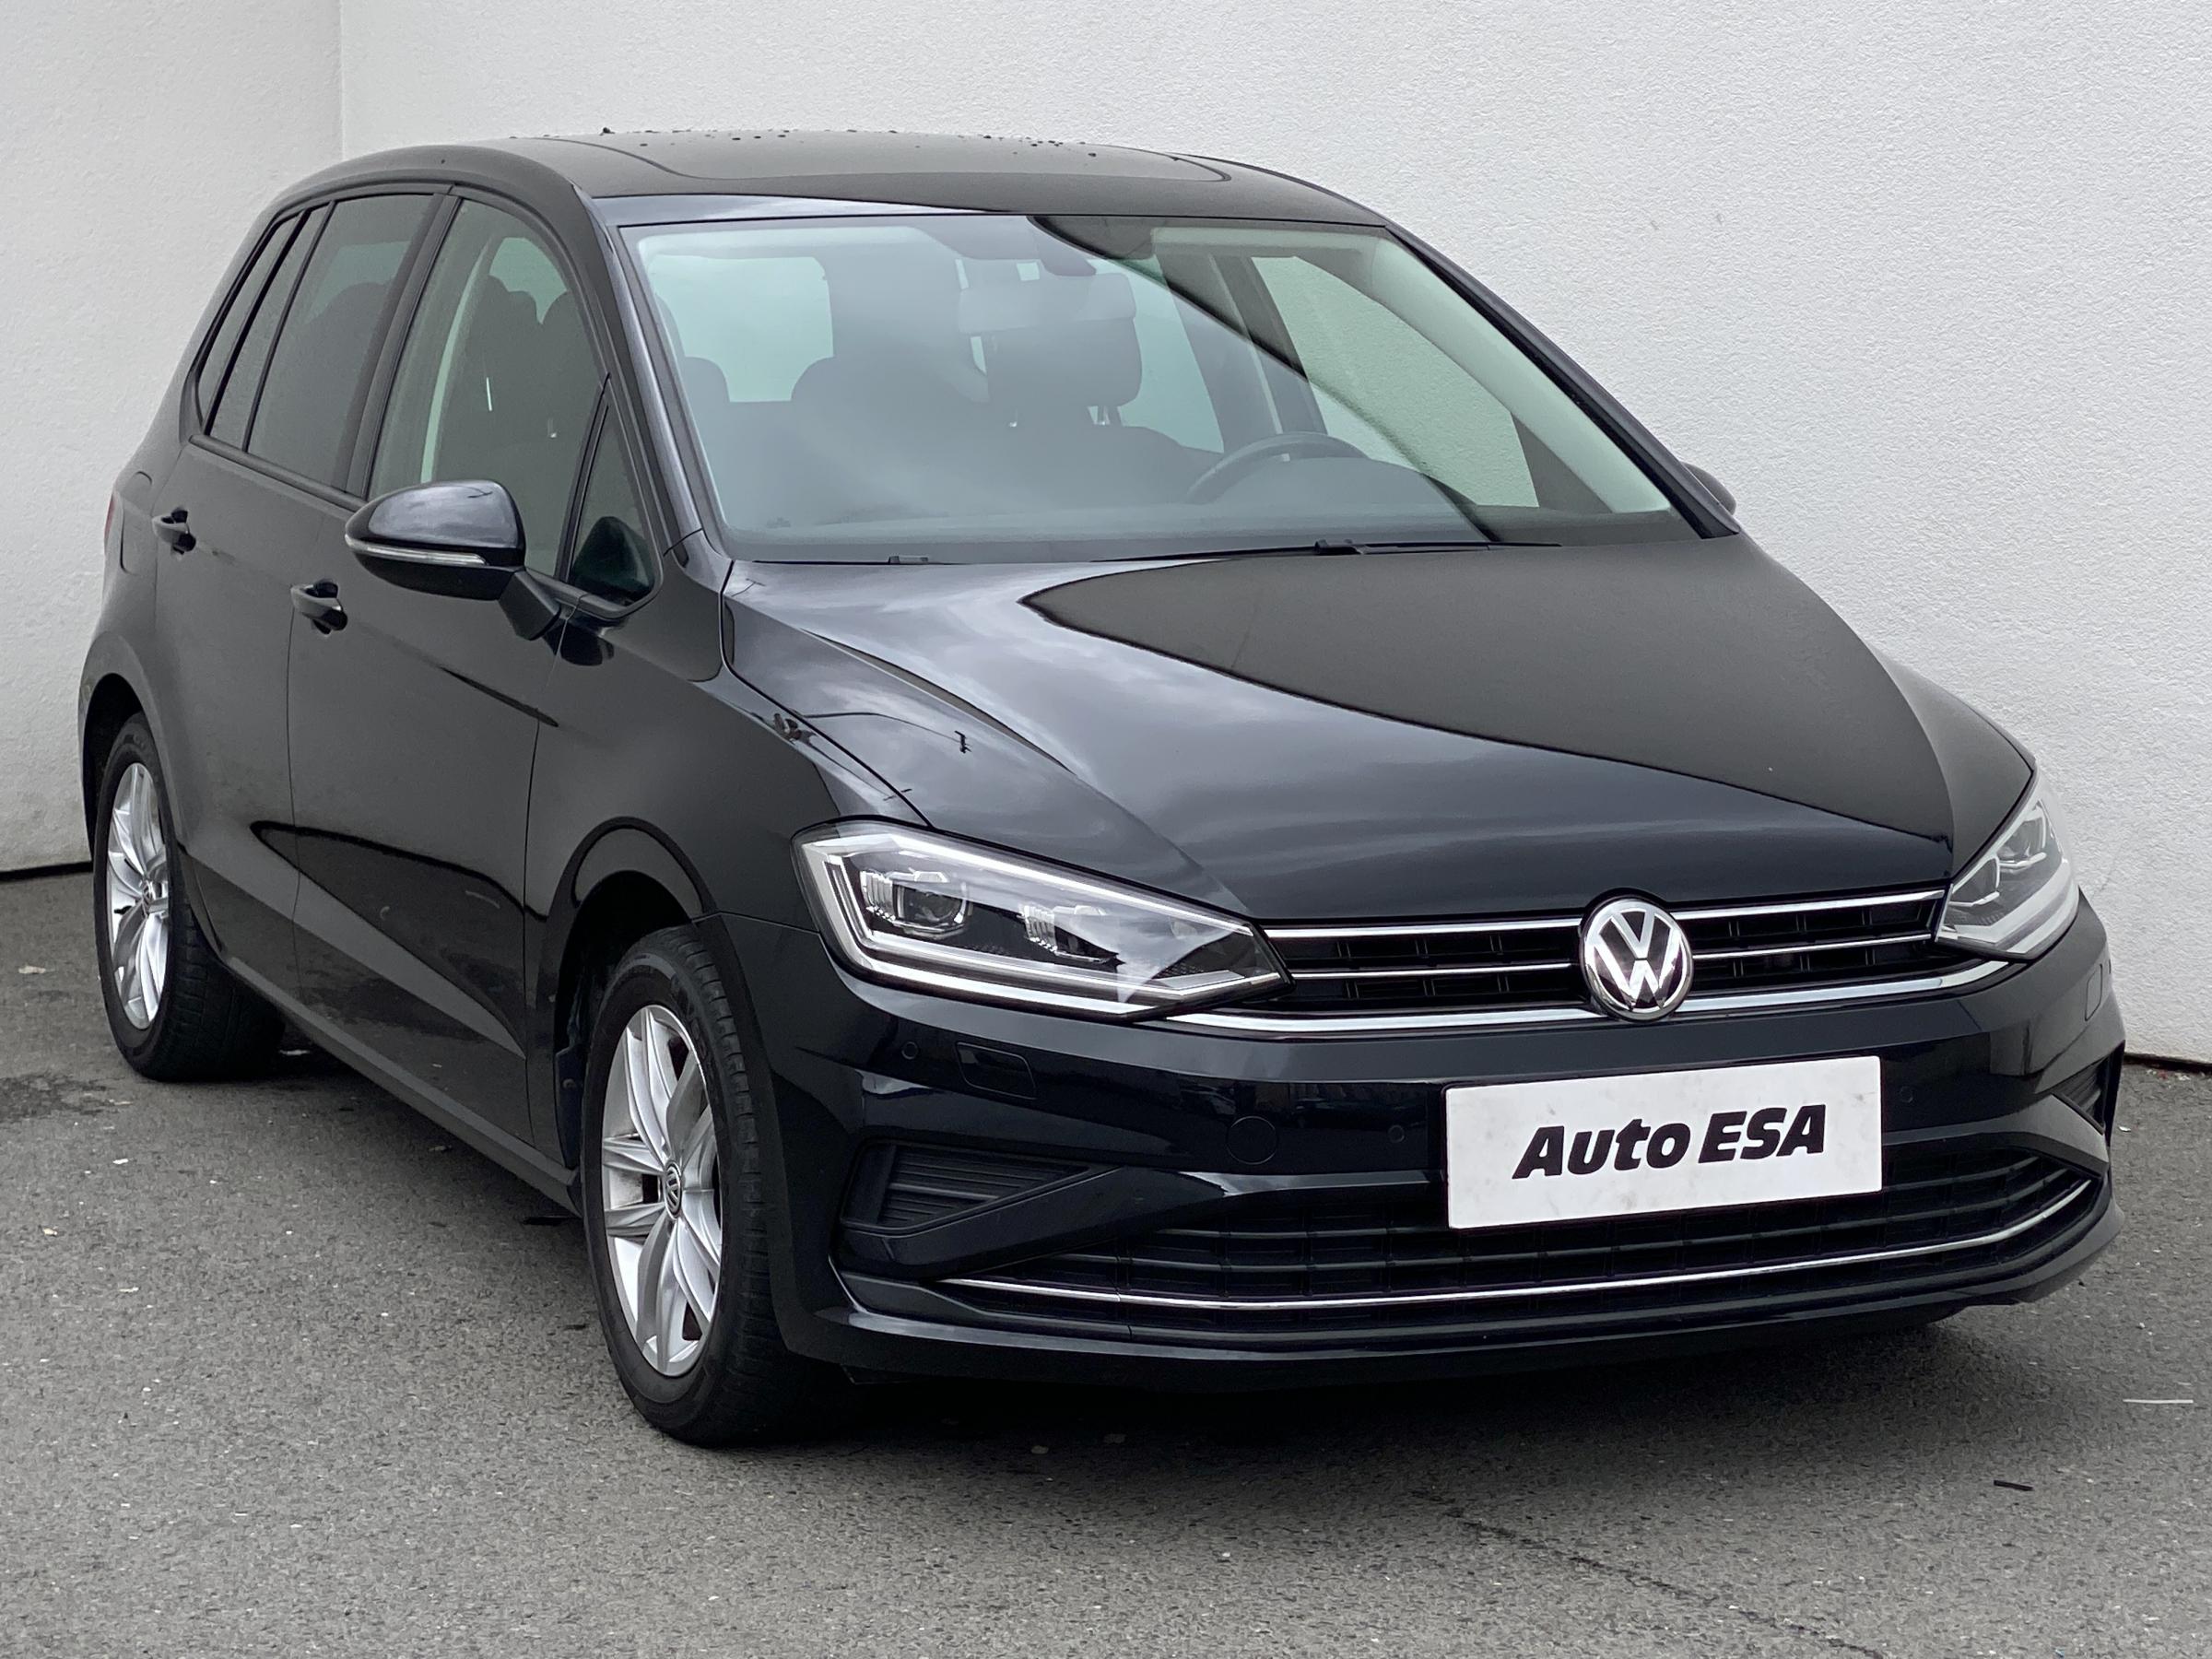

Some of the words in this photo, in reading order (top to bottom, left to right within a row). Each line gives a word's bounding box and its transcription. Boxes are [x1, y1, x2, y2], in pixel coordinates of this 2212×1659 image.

[1588, 904, 1690, 1014] VW
[1512, 1118, 1691, 1180] Auto
[1698, 1104, 1827, 1164] ESA
